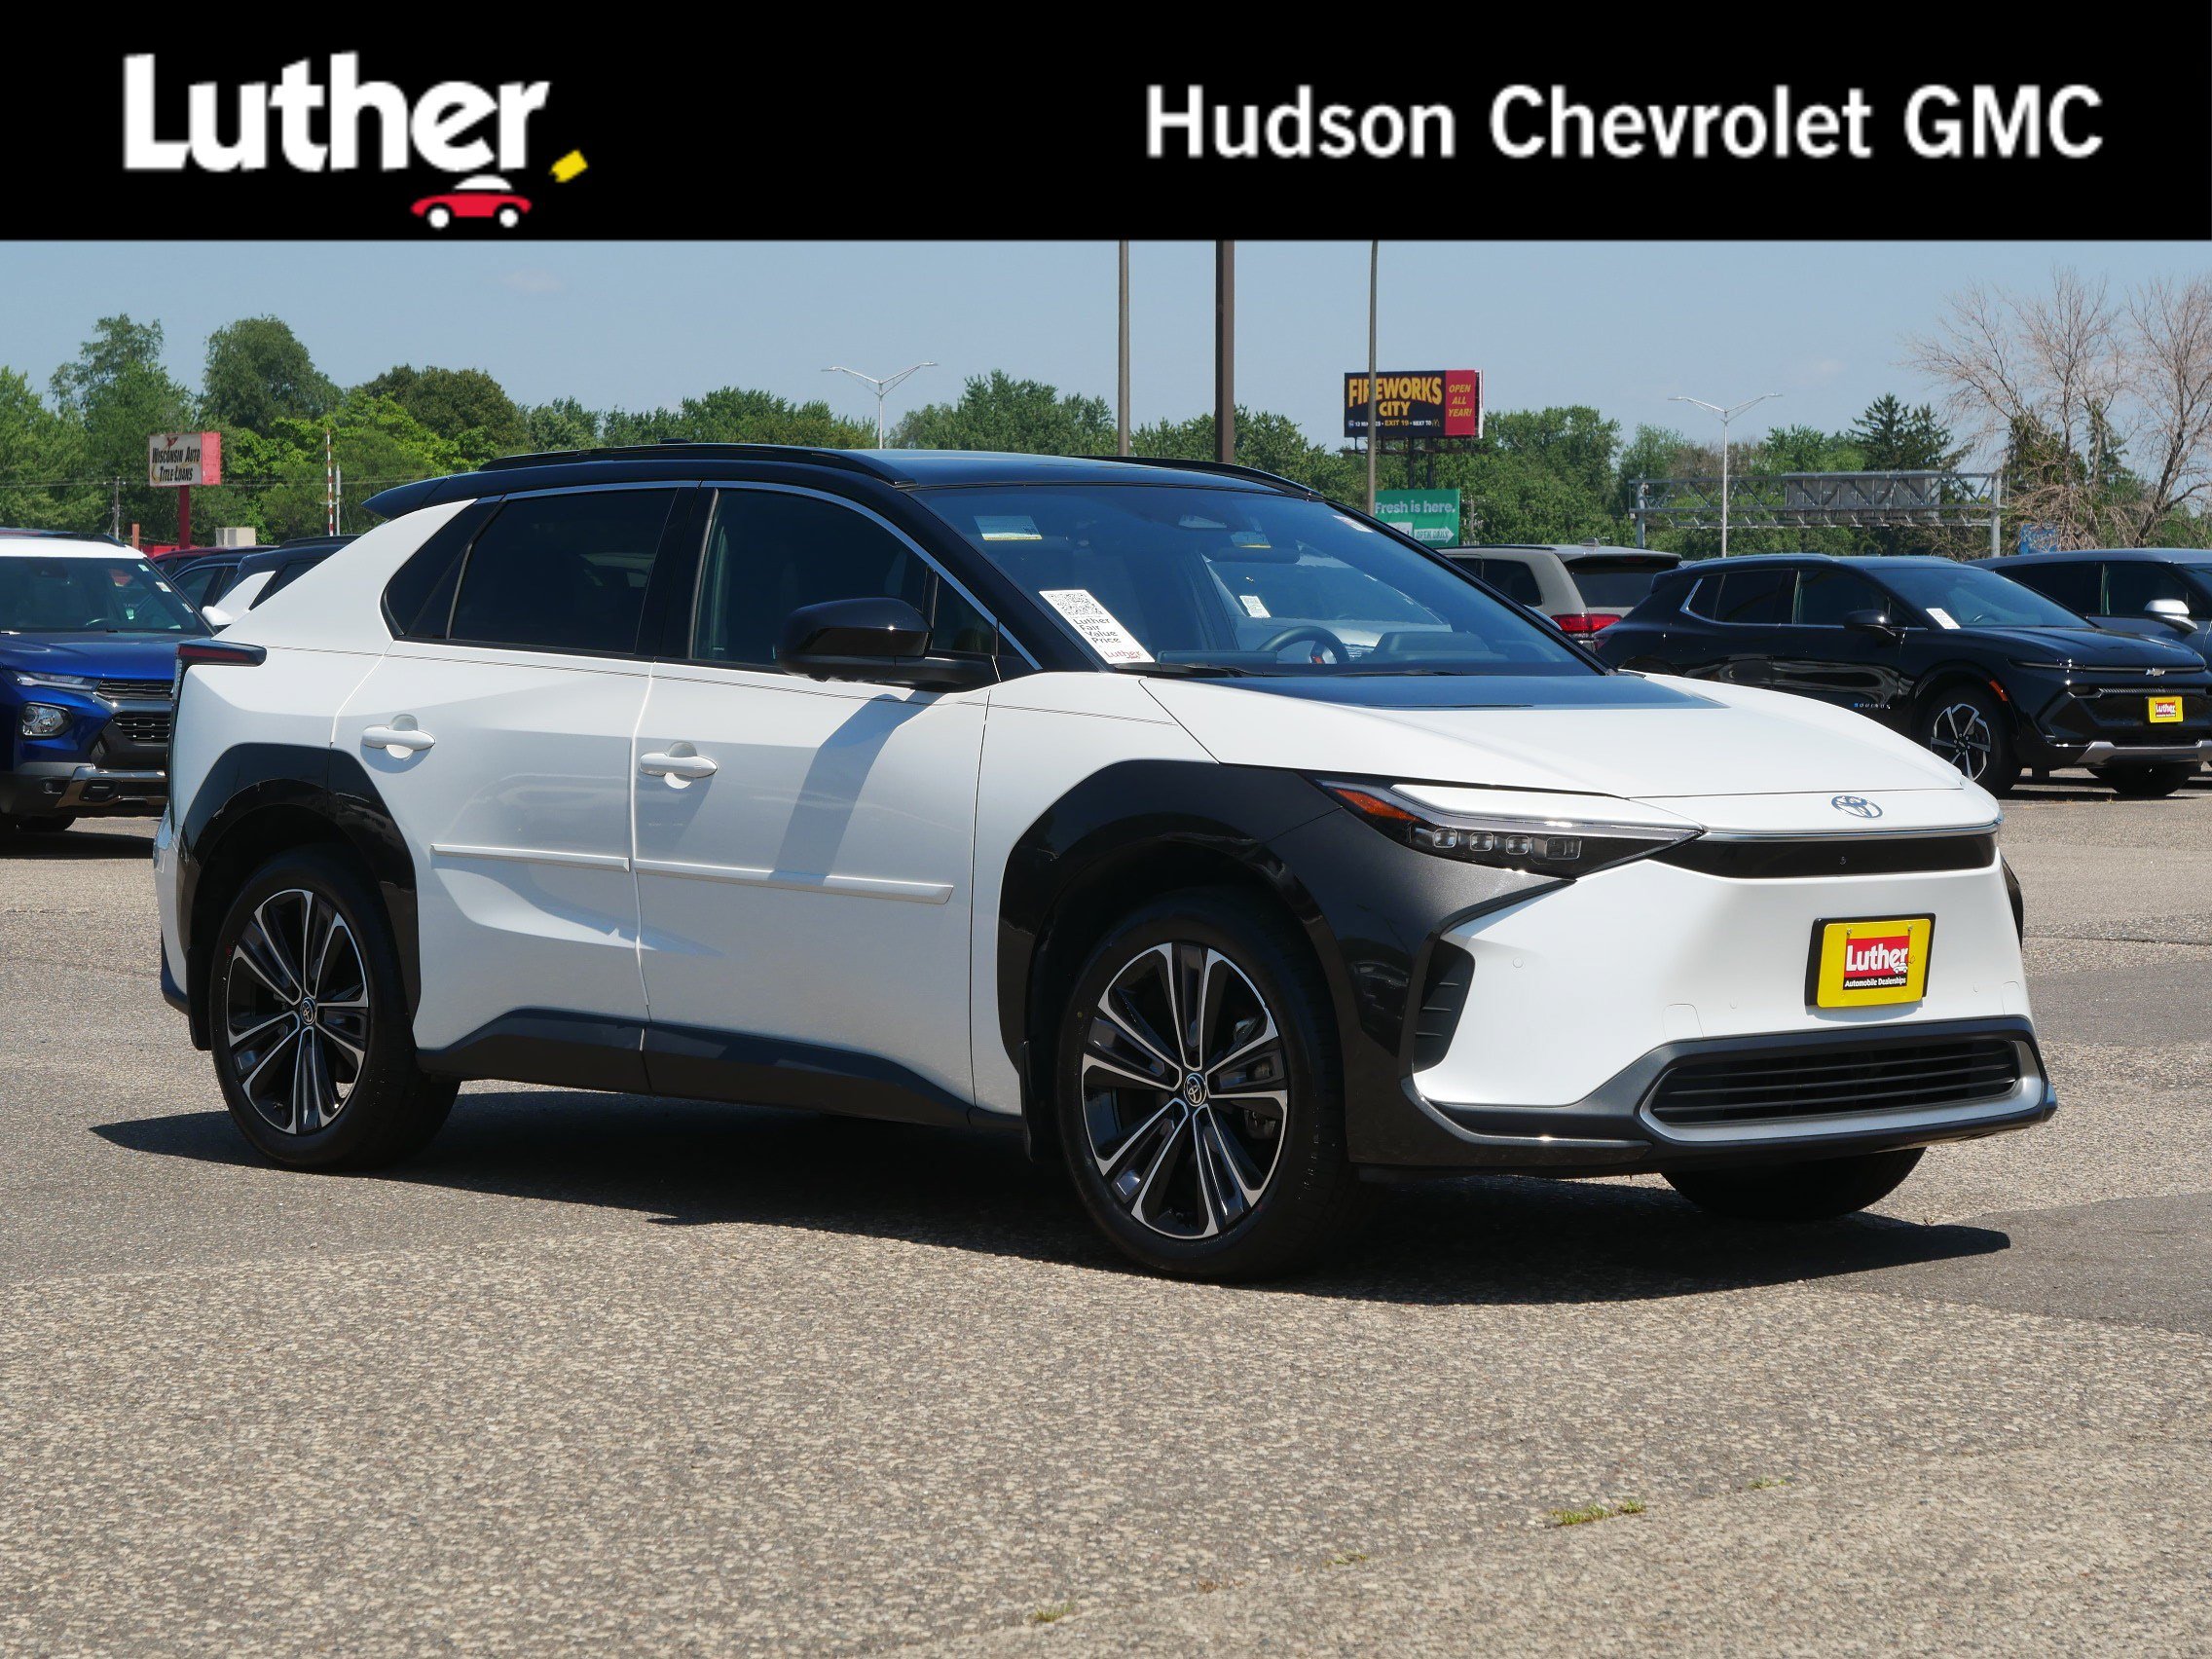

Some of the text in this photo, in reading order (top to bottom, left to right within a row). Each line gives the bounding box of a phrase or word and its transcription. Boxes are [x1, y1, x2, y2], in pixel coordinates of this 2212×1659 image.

[1449, 385, 1471, 393] OPEN
[1452, 396, 1467, 405] ALL
[1379, 400, 1411, 417] CITY
[1449, 408, 1473, 418] YEAR!
[185, 446, 201, 462] AUTO
[1375, 499, 1456, 514] Fresh is here.
[1417, 531, 1432, 539] OPEN
[1104, 650, 1142, 659] Luther
[2156, 704, 2176, 713] Luther
[1846, 943, 1908, 972] Luther
[1845, 977, 1906, 987] Automobile Dealerships
